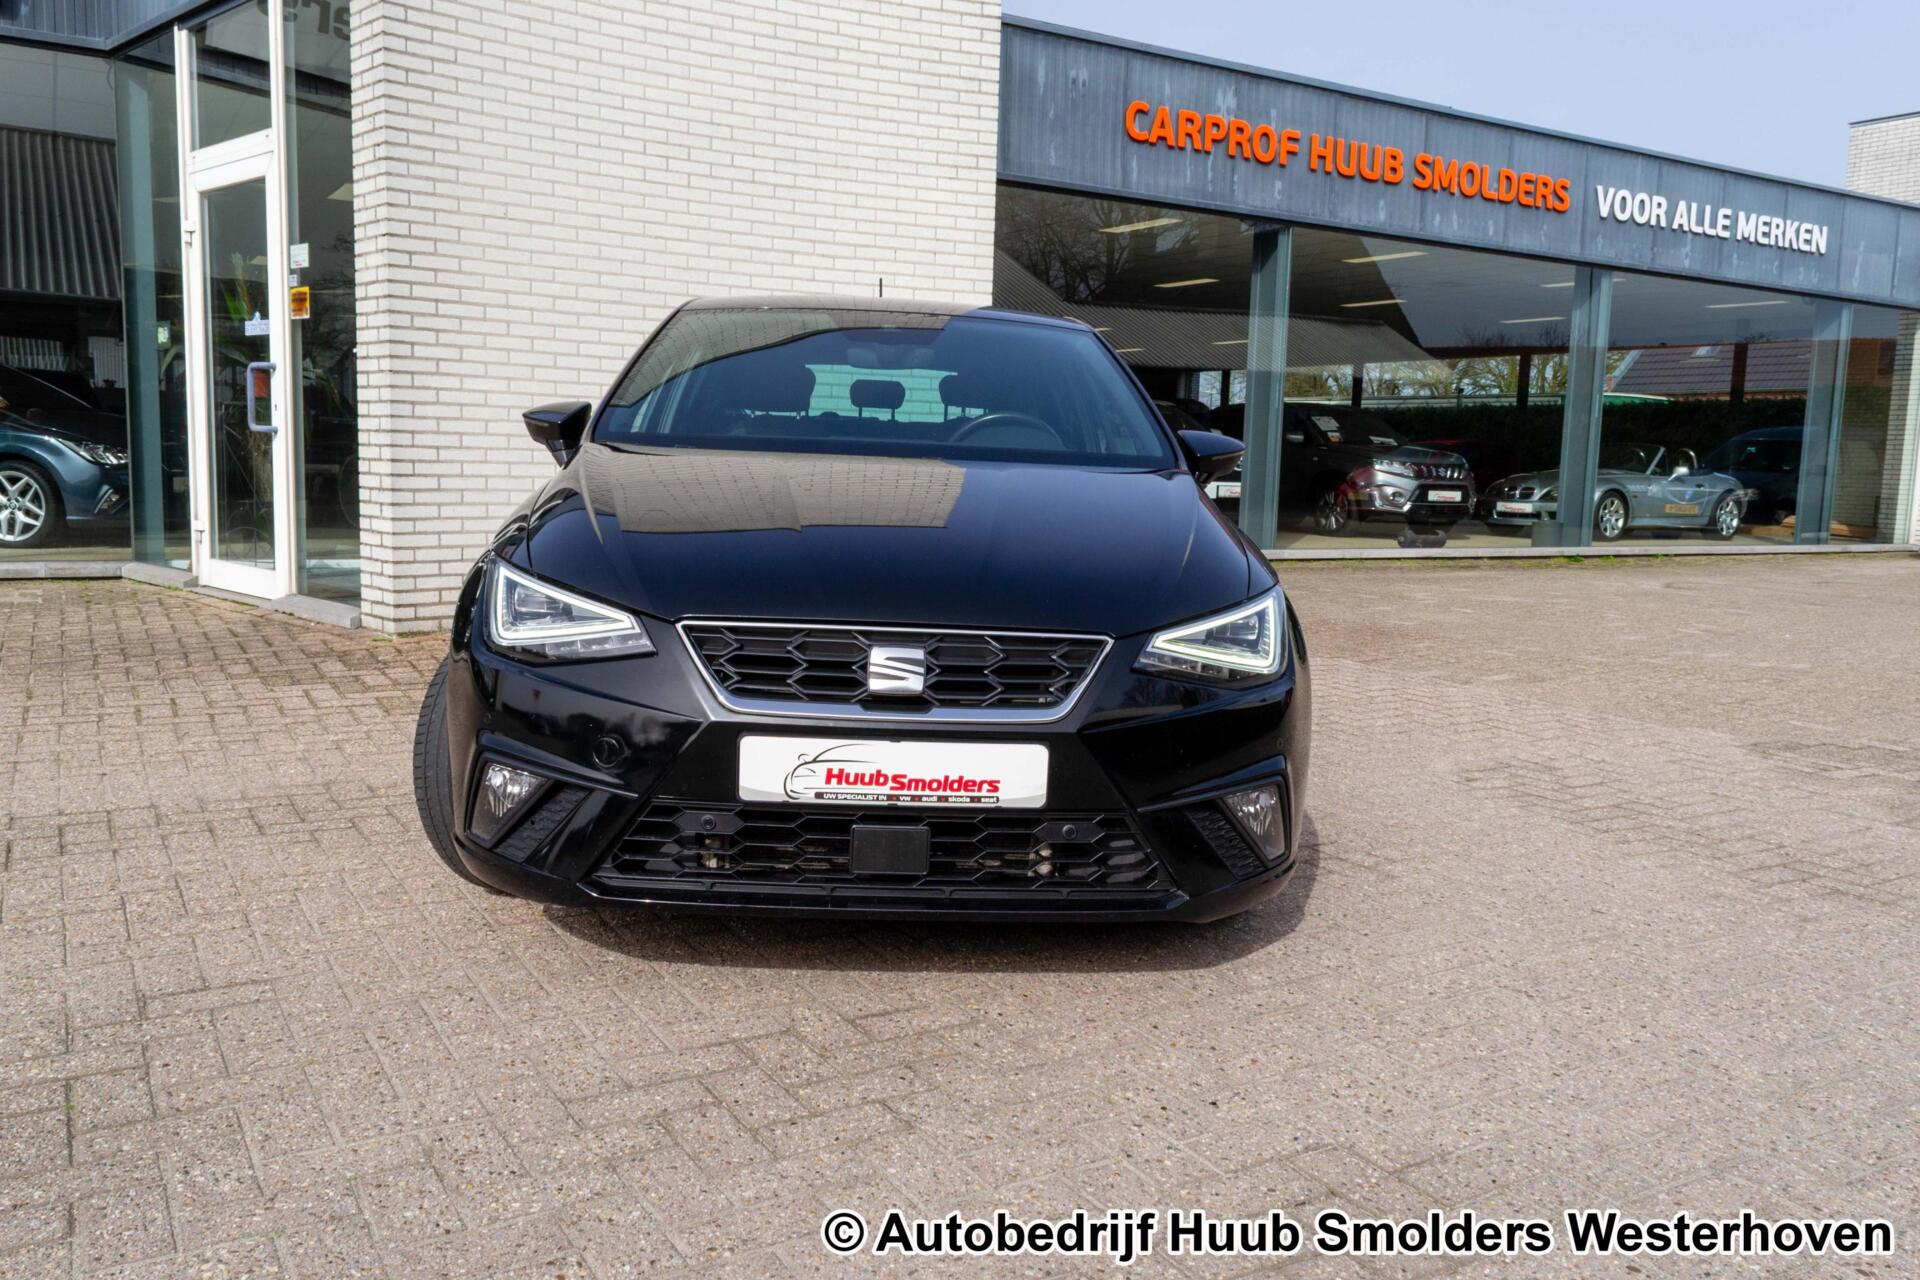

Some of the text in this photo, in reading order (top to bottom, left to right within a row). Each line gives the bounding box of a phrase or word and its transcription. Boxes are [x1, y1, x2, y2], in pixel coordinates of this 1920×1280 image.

[1125, 101, 1570, 213] CARPROF HUUB SMOLDERS
[1596, 185, 1829, 255] VOOR ALLE MERKEN
[823, 792, 837, 800] UW
[837, 793, 878, 801] SPECIALIST
[948, 795, 971, 803] skoda
